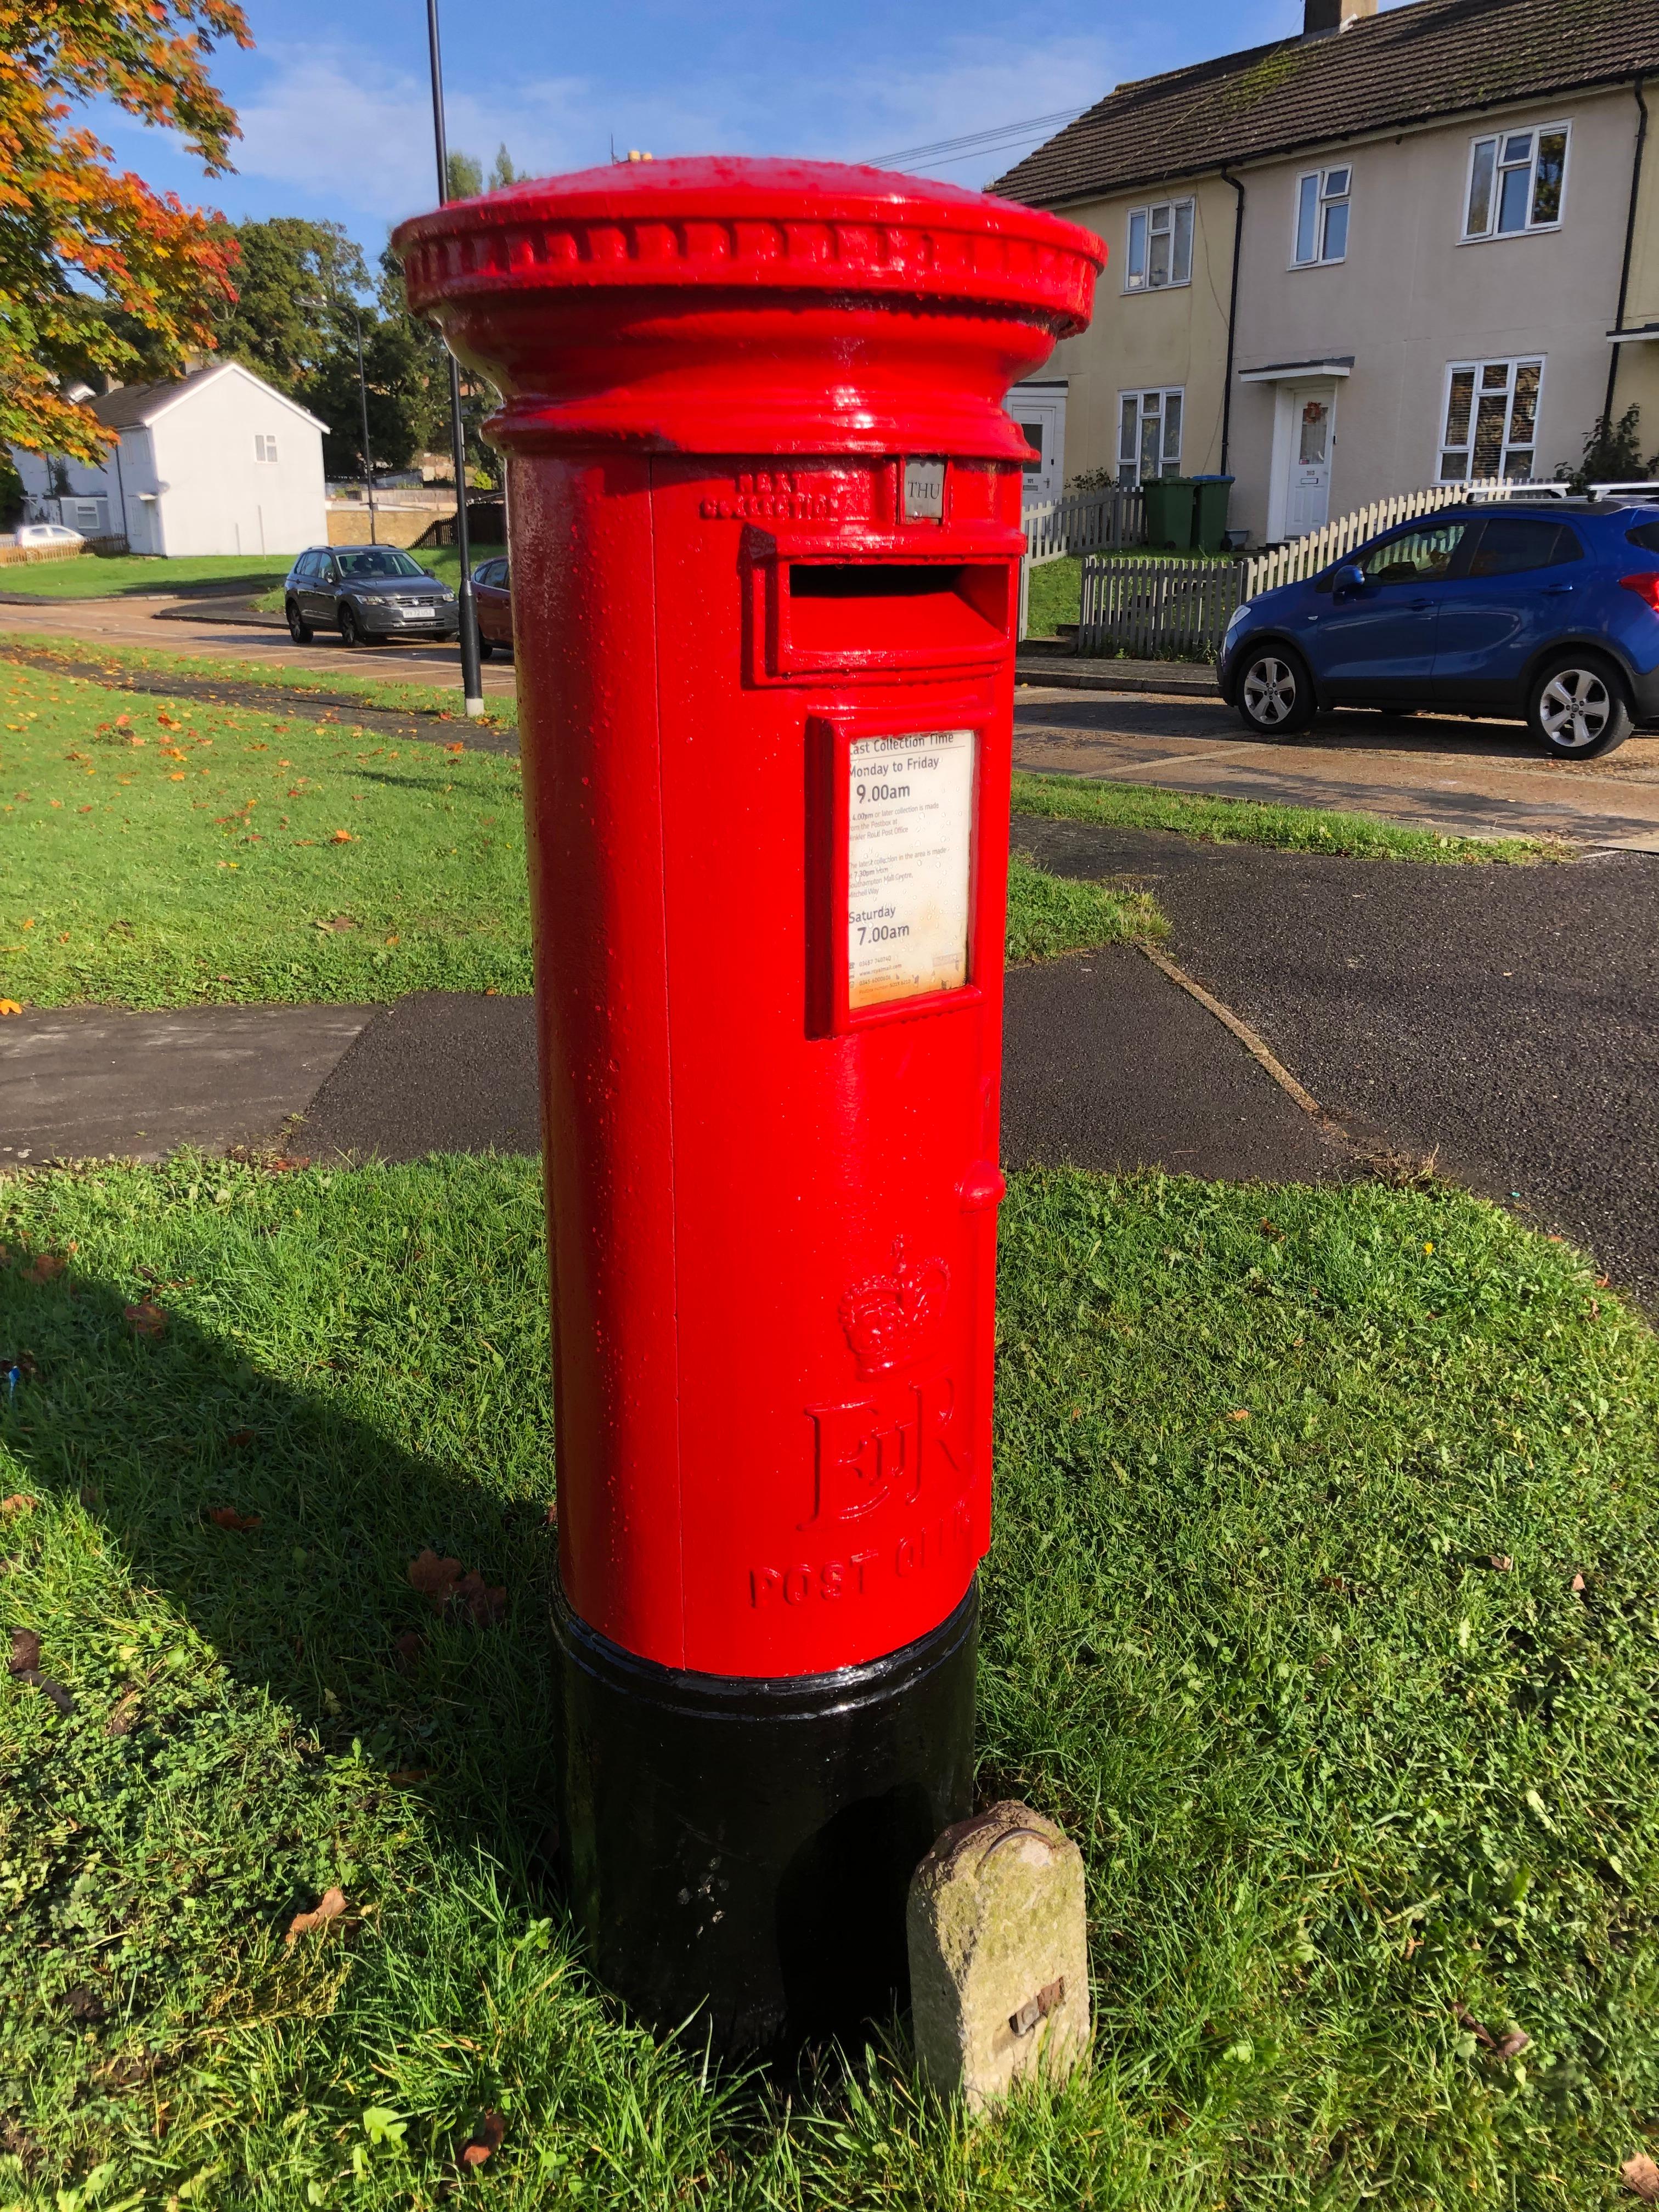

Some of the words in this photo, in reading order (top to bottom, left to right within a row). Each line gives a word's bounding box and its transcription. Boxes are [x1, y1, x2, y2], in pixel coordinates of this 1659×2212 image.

[908, 481, 940, 499] THU
[874, 735, 925, 752] Collection
[930, 733, 953, 745] Time
[893, 761, 902, 772] to
[907, 757, 939, 770] Friday
[856, 784, 910, 804] 9.00am
[853, 812, 873, 821] 4.00pm
[895, 805, 918, 815] collection
[925, 802, 939, 810] made
[871, 820, 891, 828] Postbox
[932, 847, 946, 855] made
[849, 906, 896, 923] Saturday
[857, 925, 910, 946] 7.00am
[749, 1550, 879, 1609] POST
